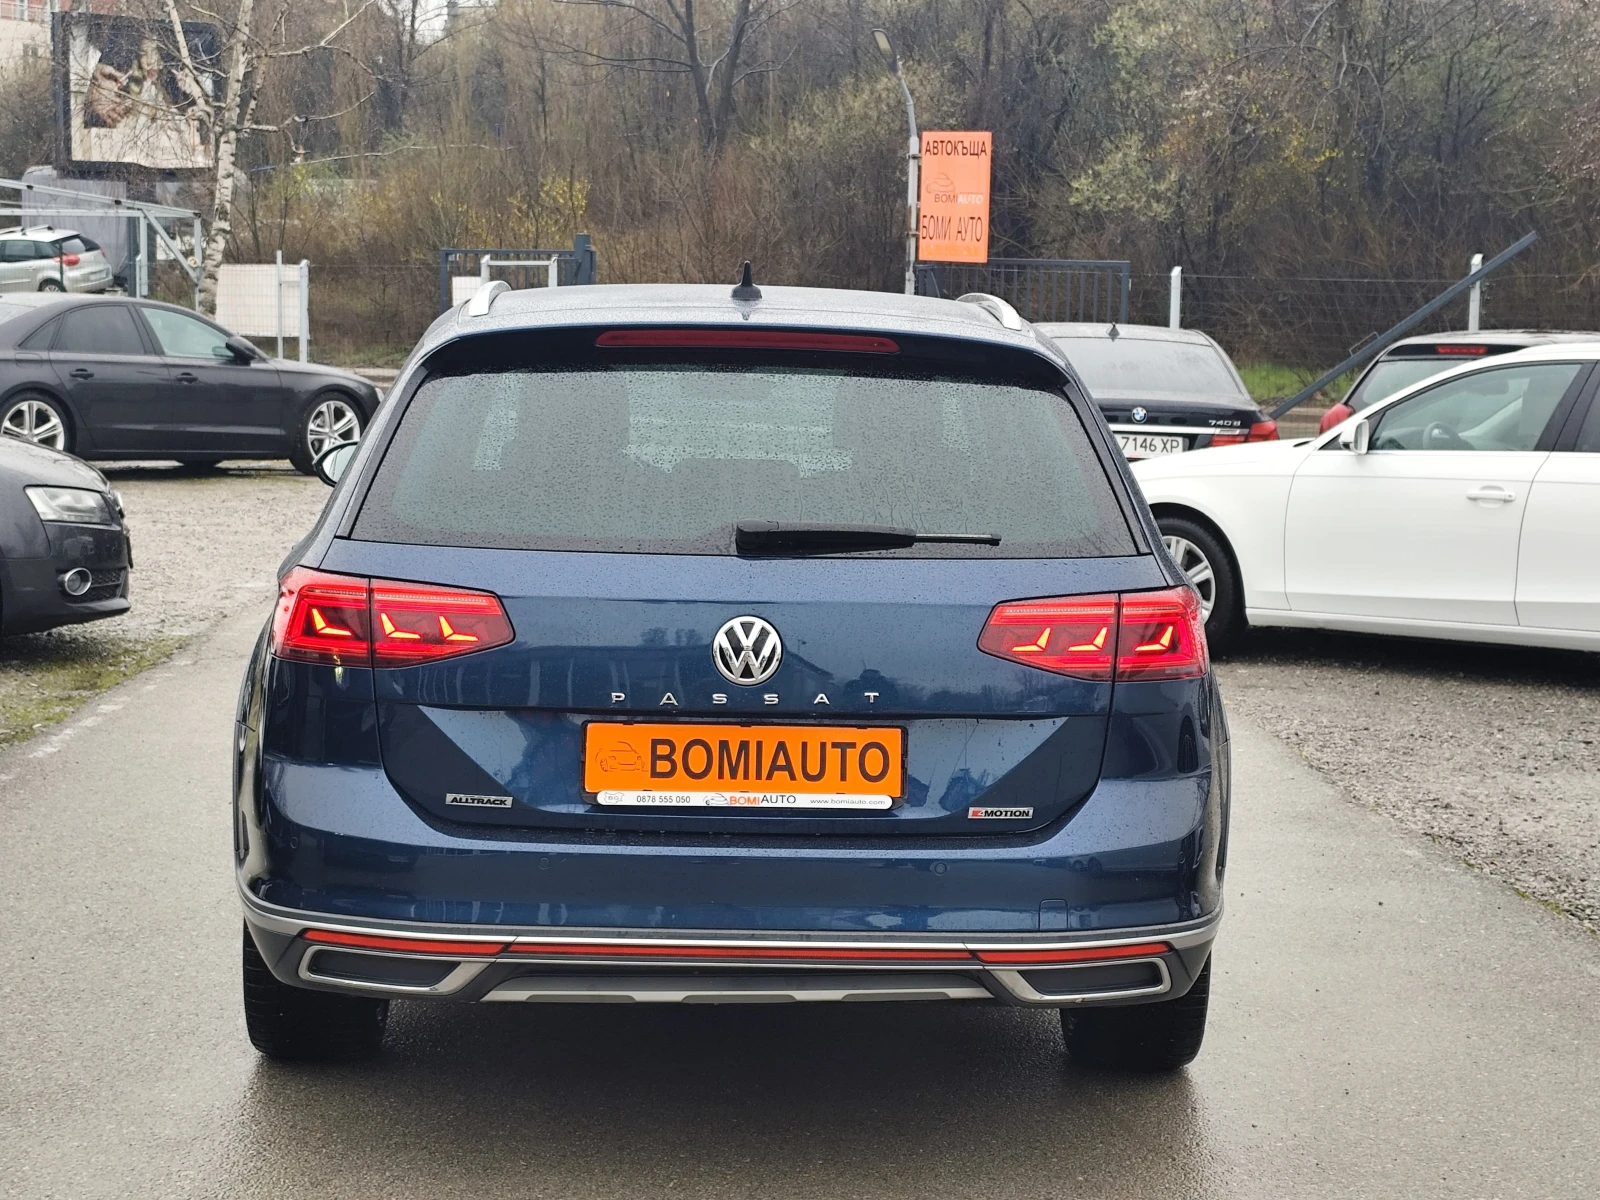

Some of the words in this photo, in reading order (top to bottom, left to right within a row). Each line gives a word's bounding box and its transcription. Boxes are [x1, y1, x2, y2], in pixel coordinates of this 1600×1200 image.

[924, 140, 987, 158] АВТОКЪЩА
[921, 215, 951, 240] БОМИ
[956, 216, 983, 242] АУТО
[1121, 436, 1157, 452] 7146
[1160, 438, 1180, 453] XP
[712, 615, 783, 686] VW
[610, 691, 880, 706] PASSAT
[650, 738, 890, 783] BOMIAUTO
[450, 796, 508, 806] ALLTRACK
[636, 795, 656, 803] 0878
[658, 795, 673, 804] 555
[675, 795, 691, 804] 050
[809, 798, 886, 806] www.bomiauto.com
